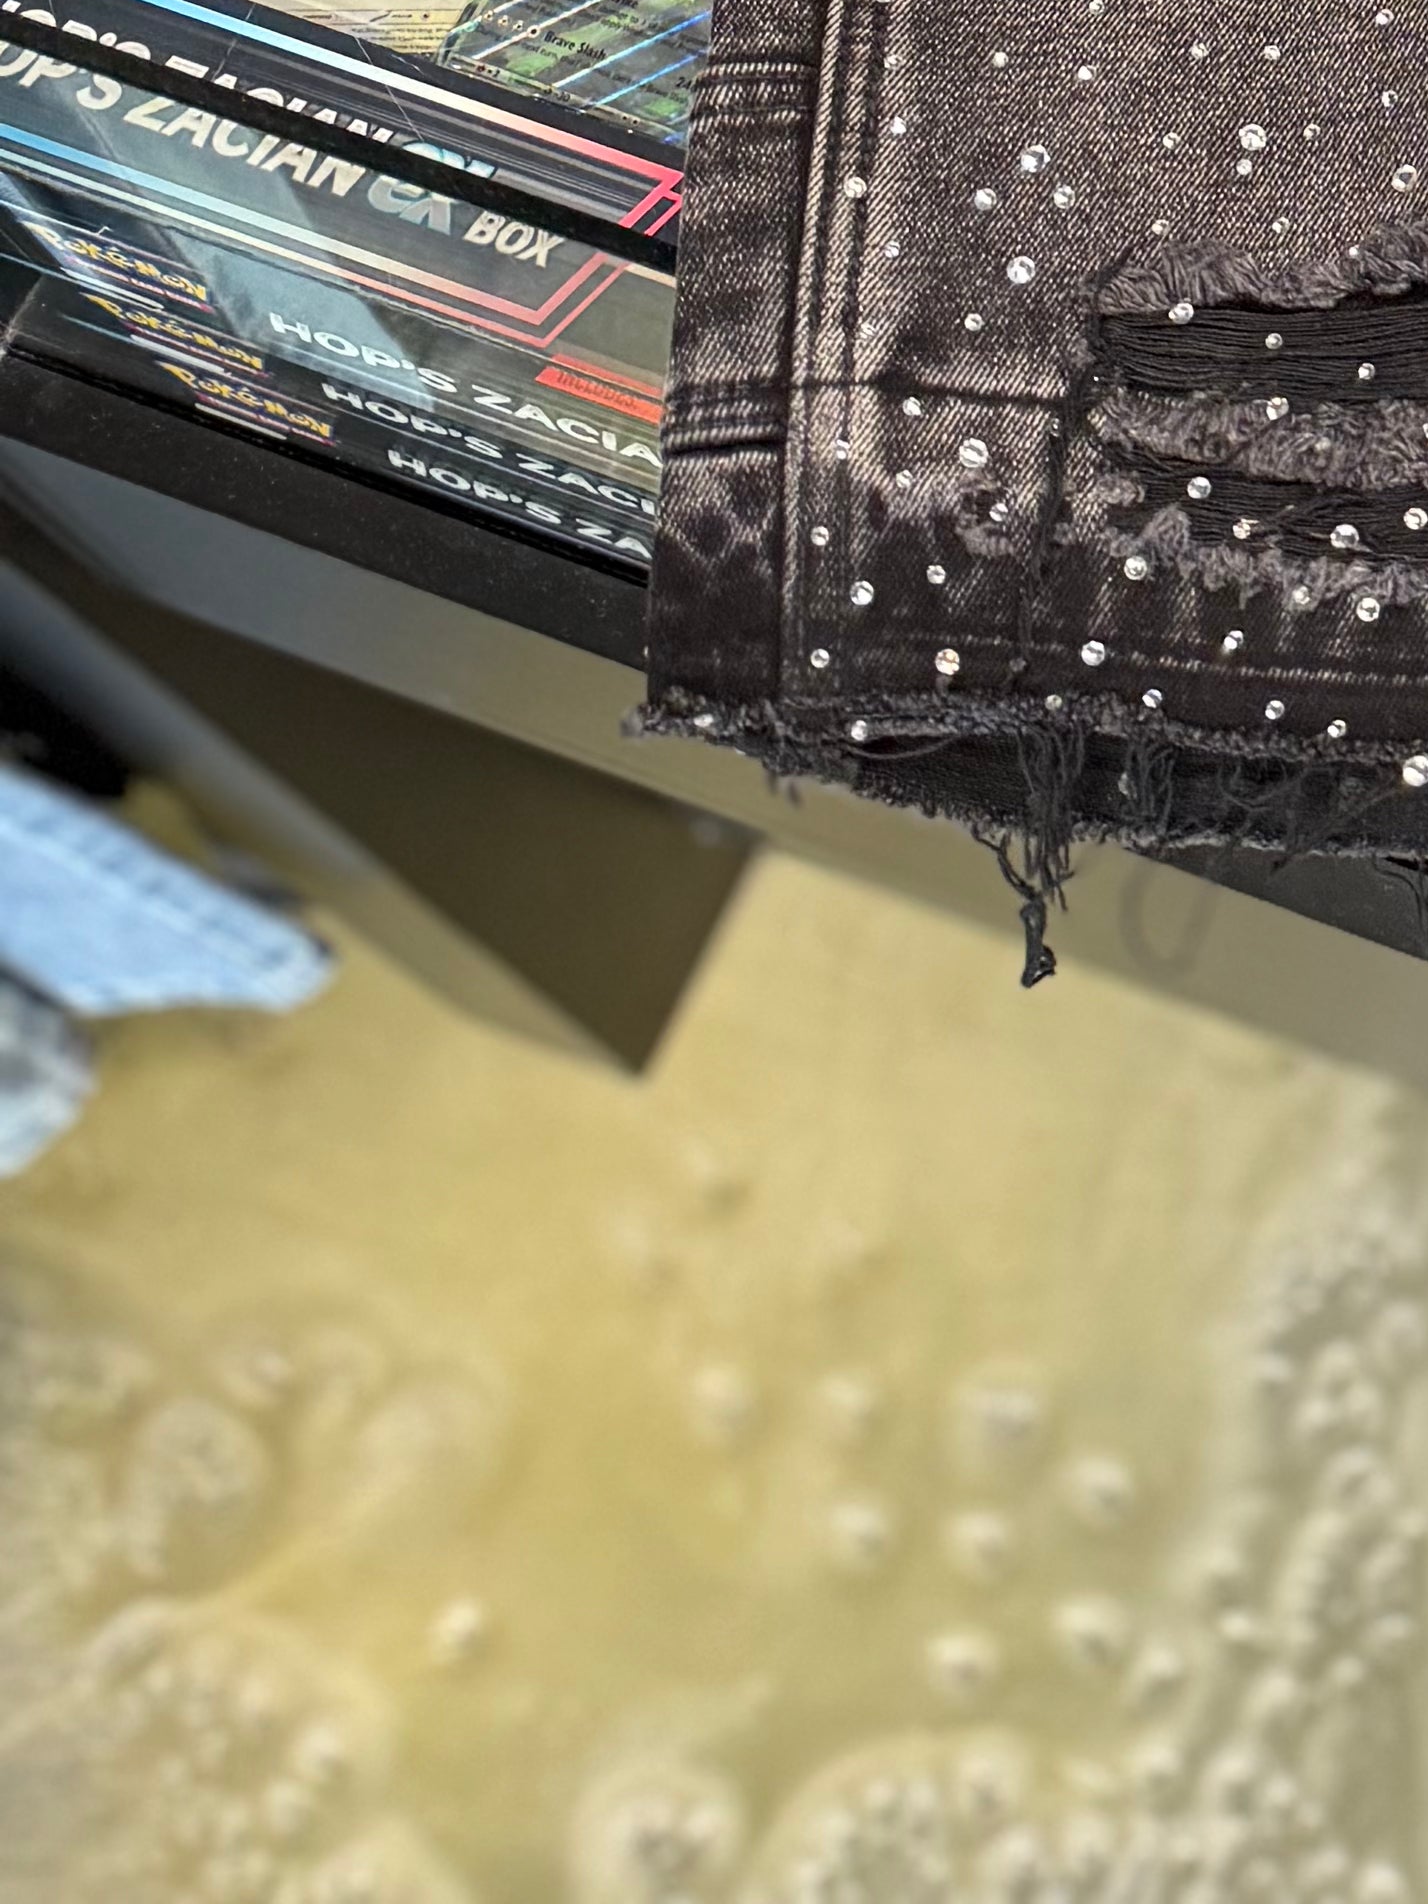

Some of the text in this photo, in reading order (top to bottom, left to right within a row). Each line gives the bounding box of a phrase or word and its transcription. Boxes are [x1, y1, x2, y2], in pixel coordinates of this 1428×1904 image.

[543, 30, 576, 51] Brave
[577, 40, 607, 60] Slash
[463, 210, 568, 268] BOX
[268, 311, 458, 394] HOP'S
[321, 381, 504, 460] HOP'S
[387, 447, 562, 525] HOP'S
